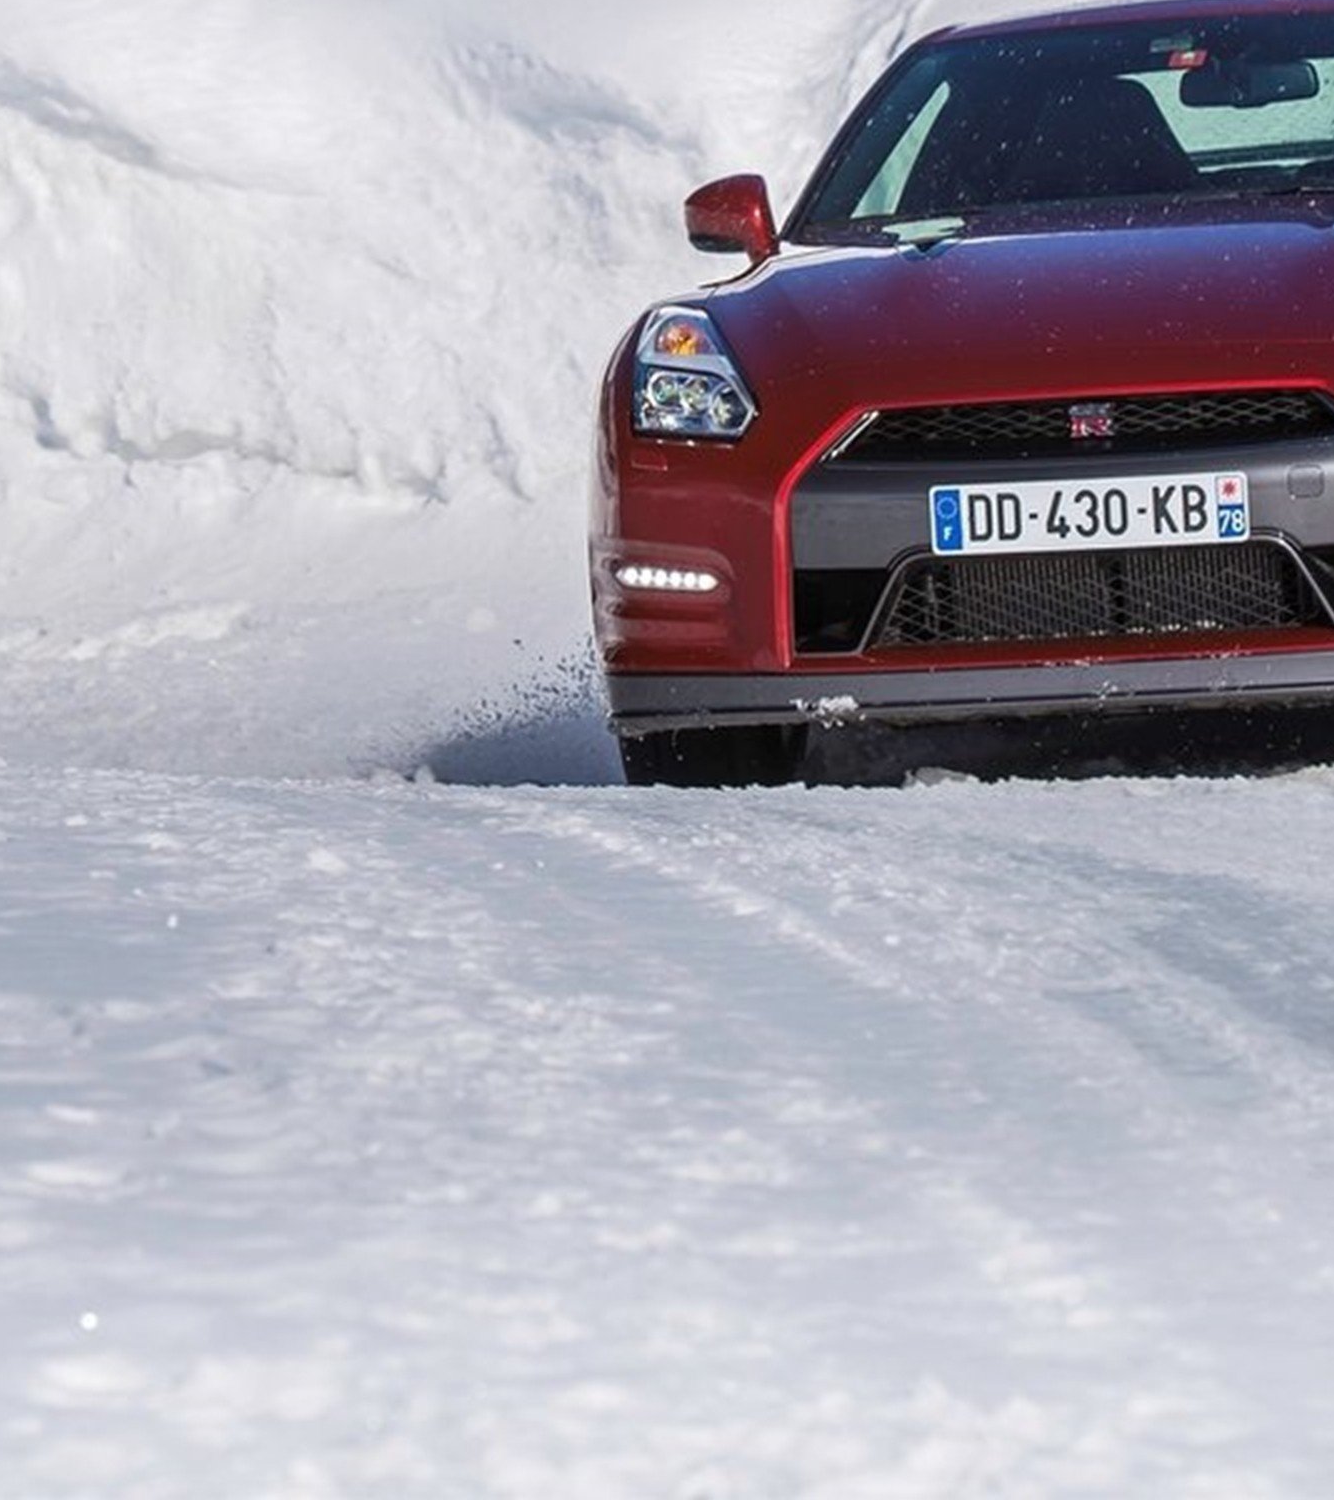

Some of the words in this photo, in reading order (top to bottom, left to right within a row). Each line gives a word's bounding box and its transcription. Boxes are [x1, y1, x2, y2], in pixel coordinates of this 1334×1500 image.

[967, 485, 1208, 542] DD-430-KB
[1219, 509, 1244, 533] 78
[943, 526, 953, 541] F
